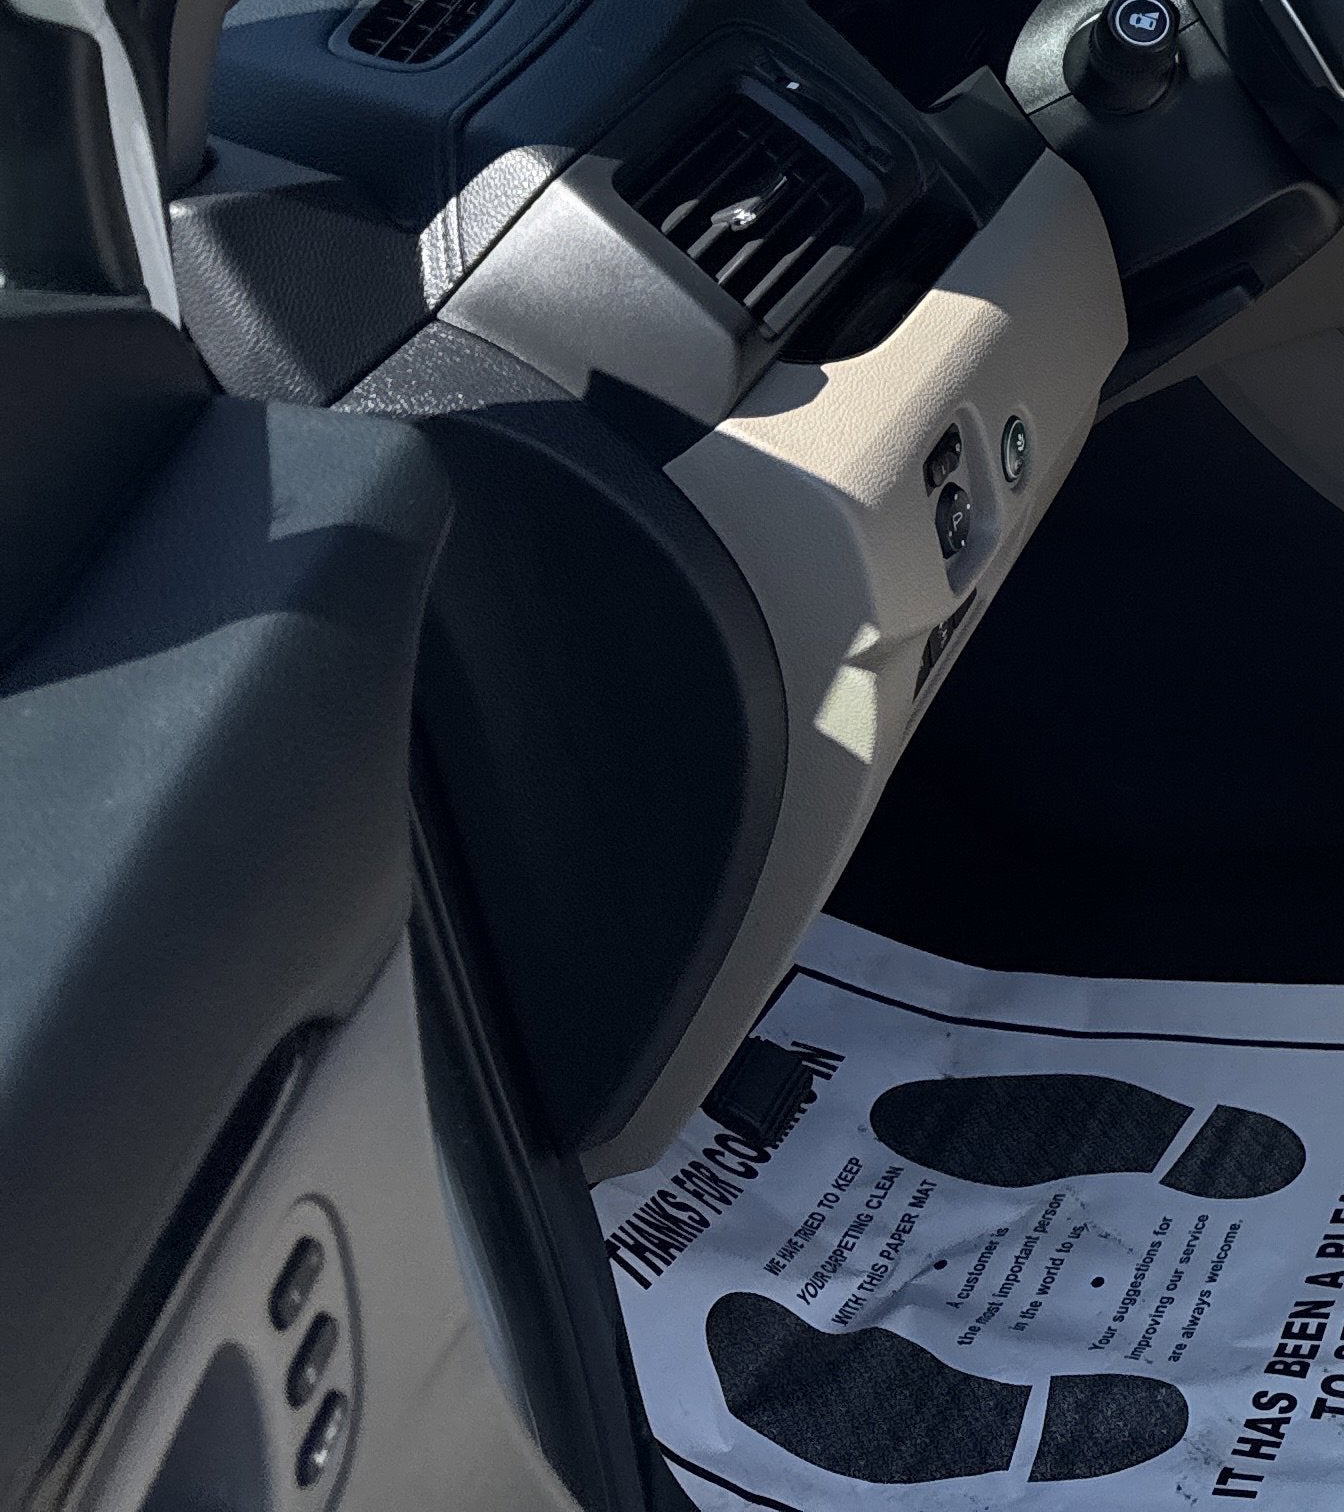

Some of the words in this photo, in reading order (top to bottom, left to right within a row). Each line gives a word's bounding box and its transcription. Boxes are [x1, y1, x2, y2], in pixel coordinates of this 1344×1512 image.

[604, 1190, 711, 1290] THANKS
[671, 1161, 744, 1215] FOR
[763, 1257, 788, 1277] WE
[776, 1238, 805, 1264] HAVE
[794, 1211, 826, 1242] TRIED
[817, 1192, 840, 1210] TO
[832, 1156, 863, 1193] KEEP
[797, 1271, 832, 1306] YOUR
[821, 1212, 874, 1274] CARPETING
[865, 1165, 905, 1210] CLEAN
[832, 1294, 868, 1327] WITH
[857, 1262, 889, 1293] THIS
[879, 1212, 920, 1261] PAPER
[908, 1178, 938, 1209] MAT
[946, 1301, 964, 1309] A
[957, 1239, 1000, 1300] customer
[957, 1325, 981, 1346] the
[975, 1301, 1004, 1326] most
[992, 1235, 1040, 1299] important
[1033, 1192, 1066, 1235] person
[1019, 1300, 1042, 1320] the
[1036, 1256, 1065, 1296] world
[1055, 1240, 1074, 1254] to
[1088, 1326, 1118, 1351] Your
[1112, 1240, 1162, 1323] suggestions
[1153, 1216, 1173, 1237] for
[1124, 1295, 1175, 1361] improving
[1166, 1268, 1185, 1292] our
[1179, 1213, 1209, 1265] service
[1168, 1343, 1187, 1362] are
[1181, 1289, 1212, 1339] always
[1205, 1219, 1244, 1284] welcome.
[1263, 1300, 1336, 1379] BEEN
[1211, 1466, 1265, 1499] IT
[1230, 1390, 1298, 1461] HAS
